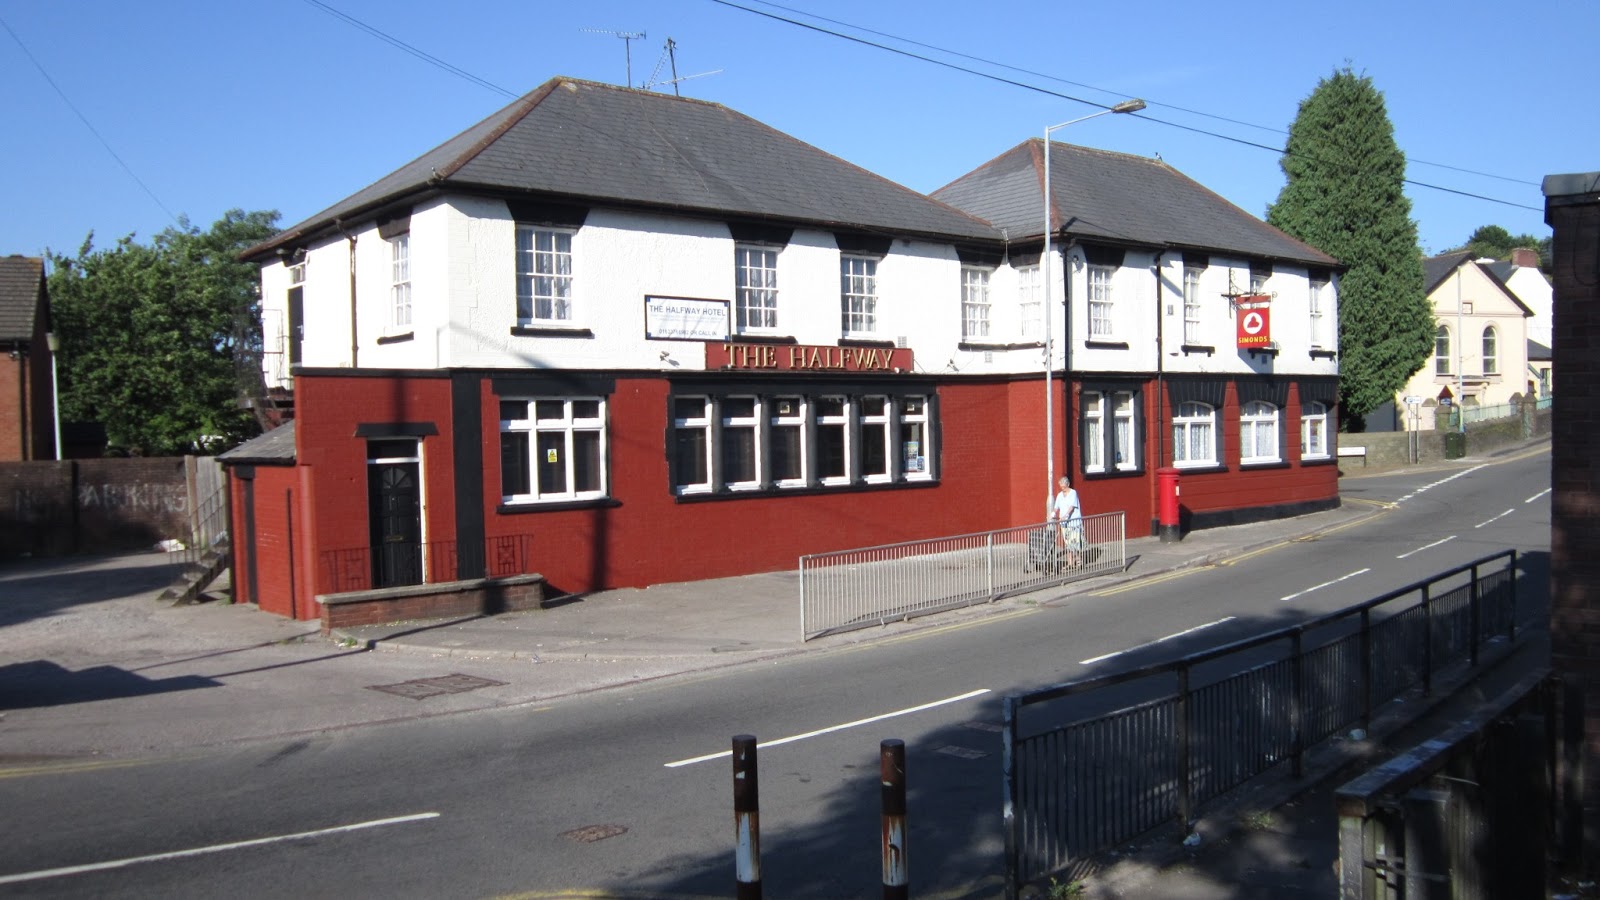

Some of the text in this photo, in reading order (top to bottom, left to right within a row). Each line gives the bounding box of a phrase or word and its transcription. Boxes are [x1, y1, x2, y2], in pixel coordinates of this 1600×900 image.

[650, 305, 663, 313] THE
[666, 306, 700, 314] HALFWAY
[724, 344, 894, 370] THE HALFWAY
